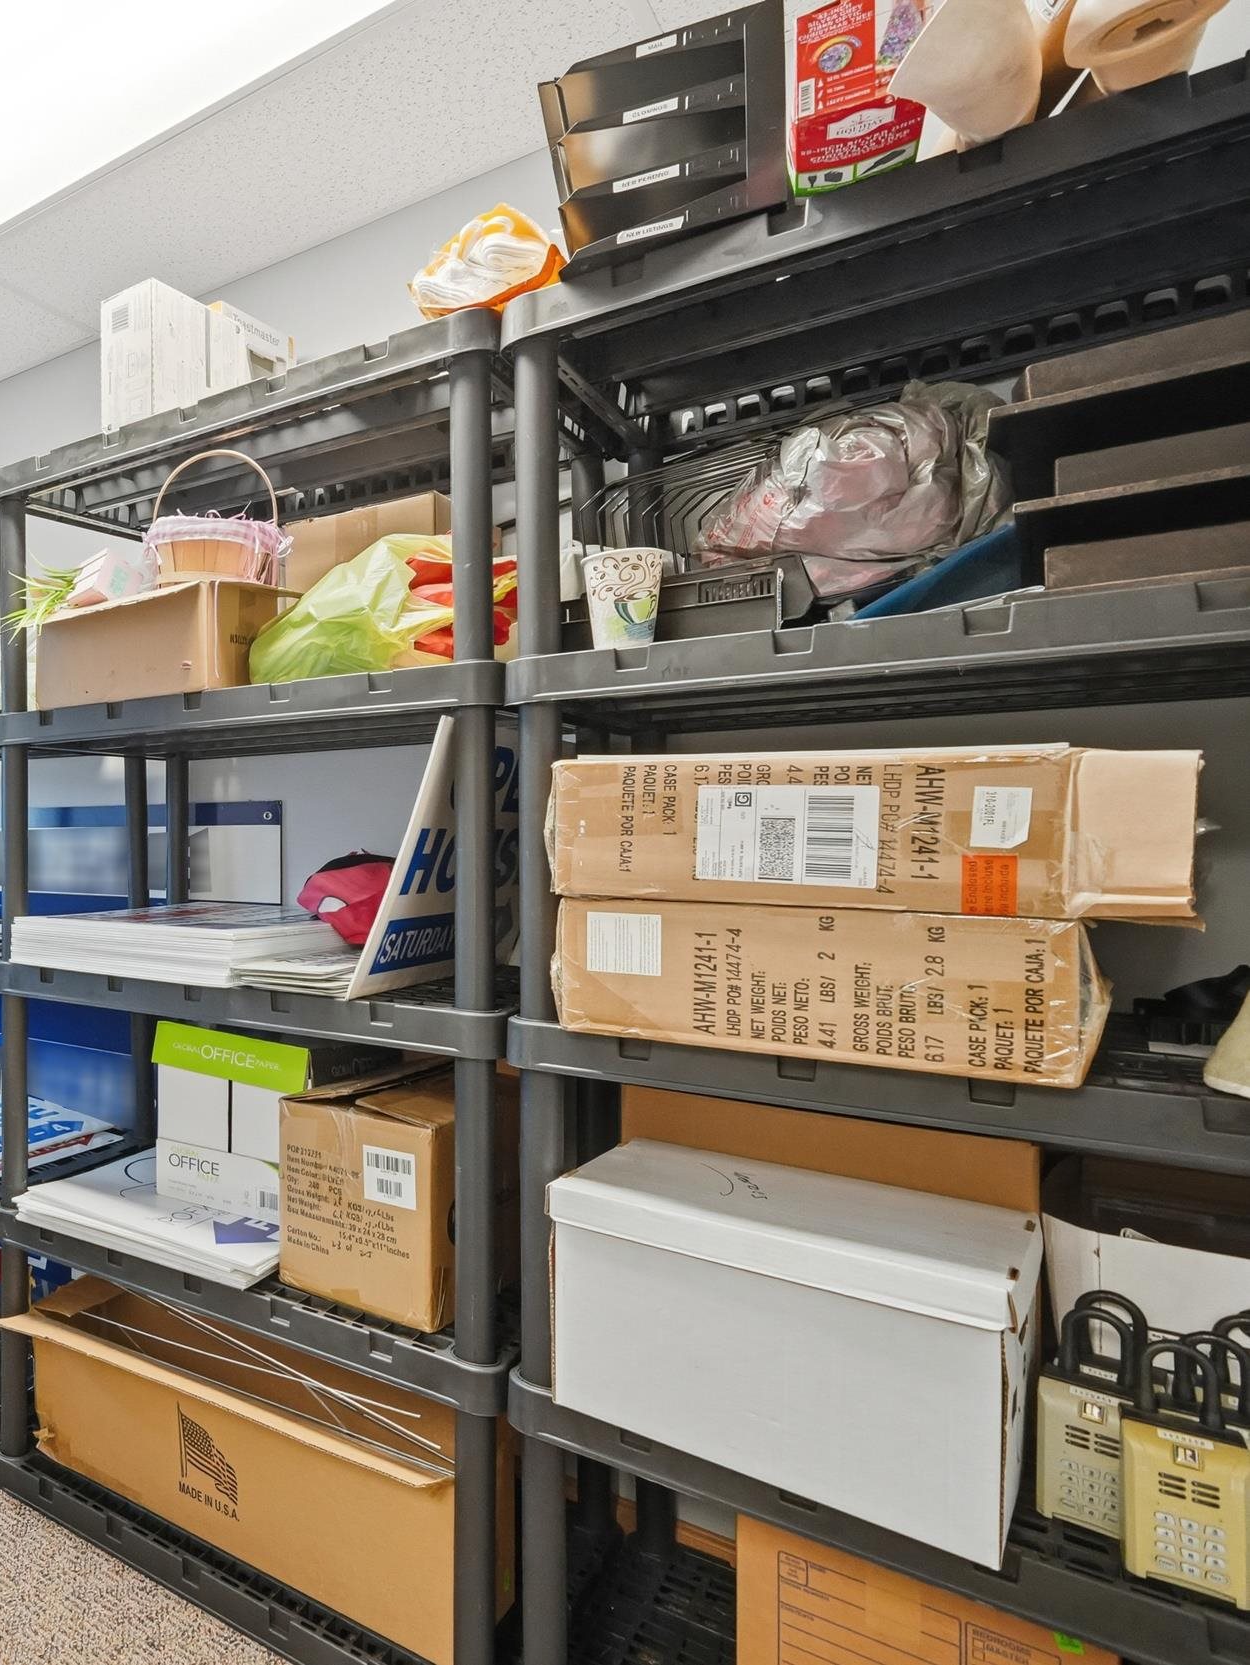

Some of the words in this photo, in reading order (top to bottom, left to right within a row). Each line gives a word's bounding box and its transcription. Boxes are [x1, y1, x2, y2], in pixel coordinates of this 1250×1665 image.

[232, 312, 280, 347] Toastmaster
[621, 765, 637, 812] PAQUETE
[663, 764, 677, 791] CASE
[883, 764, 902, 798] LHDP
[620, 814, 634, 837] POR
[662, 796, 676, 825] PACK:
[911, 765, 945, 880] AHW-M1241-1
[876, 834, 897, 894] 14474-4
[966, 860, 978, 904] Enclosed
[819, 915, 835, 931] KG
[927, 926, 945, 943] KG
[725, 928, 742, 982] 14474-4
[817, 951, 835, 961] 2
[925, 954, 944, 977] 2.8
[1025, 948, 1046, 984] CAJA:
[693, 931, 717, 1035] AHW-M1241-1
[751, 970, 766, 1015] WEIGHT:
[772, 981, 787, 1007] NET:
[794, 977, 810, 1012] NETO:
[854, 962, 872, 1009] WEIGHT:
[877, 984, 894, 1019] BRUT:
[969, 995, 989, 1033] PACK:
[1025, 988, 1044, 1014] POR
[725, 1007, 741, 1037] LHDP
[751, 1018, 765, 1040] NET
[771, 1010, 787, 1043] POIDS
[793, 1016, 809, 1045] PESO
[817, 1021, 837, 1049] 4.41
[853, 1012, 870, 1052] GROSS
[876, 1023, 893, 1056] POIDS
[897, 1027, 915, 1059] PESO
[924, 1035, 944, 1063] 6.17
[968, 1034, 986, 1069] CASE
[994, 1020, 1013, 1071] PAQUET:
[1023, 1019, 1044, 1074] PAQUETE
[172, 1041, 200, 1053] GLOBAL
[200, 1043, 255, 1069] OFFICE
[168, 1153, 220, 1177] OFFICE
[286, 1154, 300, 1164] Item
[286, 1165, 300, 1174] Item
[286, 1195, 299, 1204] Net
[328, 1185, 343, 1196] PCS
[286, 1224, 307, 1239] Carton
[286, 1235, 302, 1246] Made
[310, 1241, 330, 1256] China
[386, 1234, 397, 1245] cm
[178, 1480, 203, 1503] MADE
[204, 1493, 213, 1508] IN
[214, 1499, 240, 1522] U.S.A.
[972, 1628, 1032, 1658] BEDROOMS
